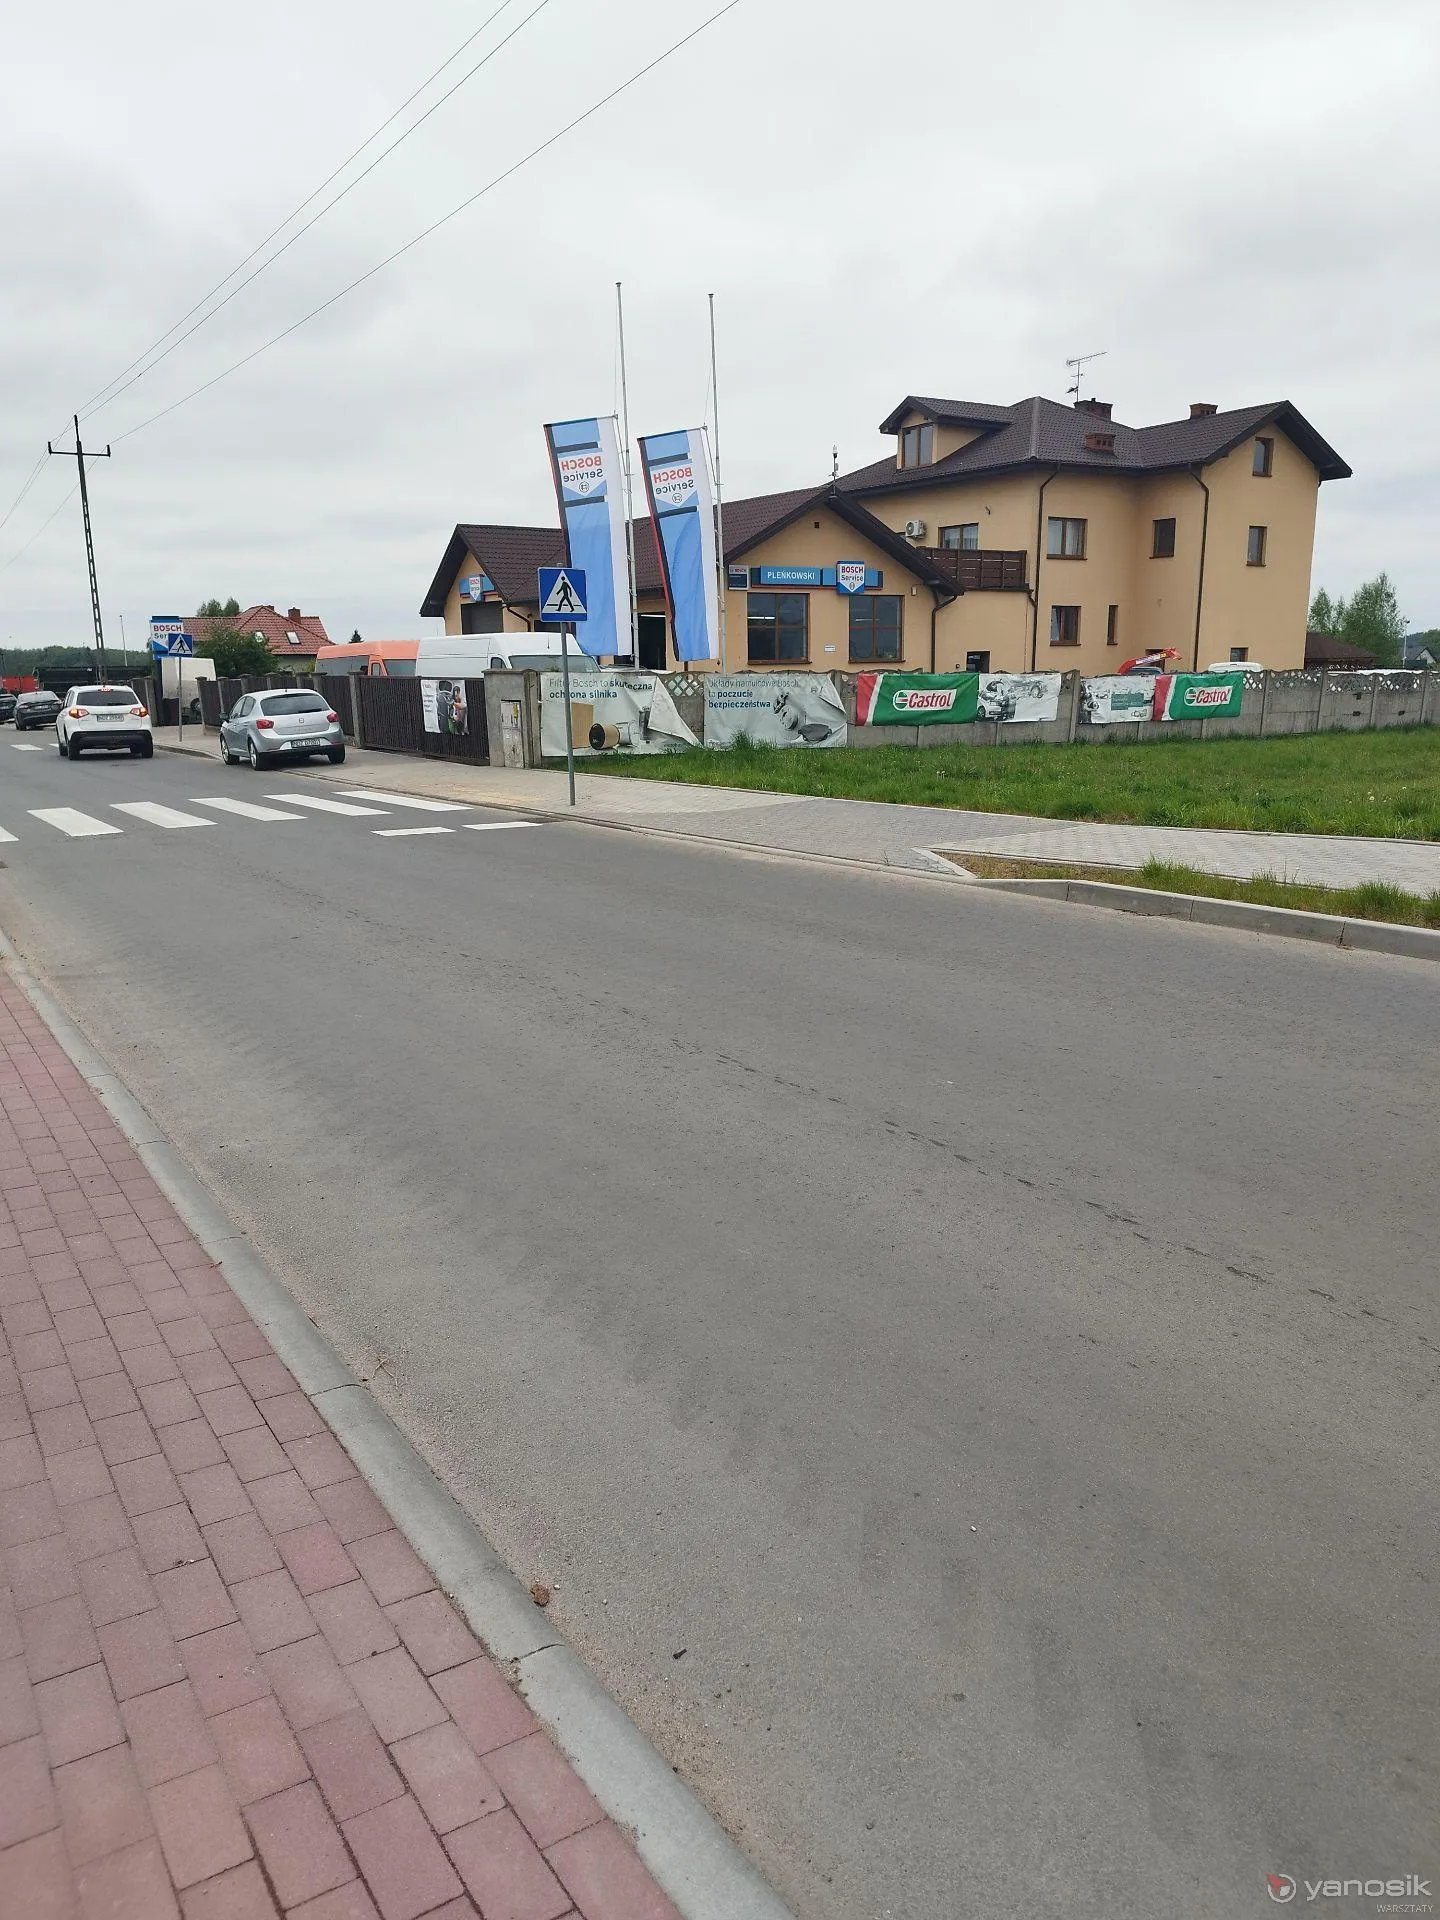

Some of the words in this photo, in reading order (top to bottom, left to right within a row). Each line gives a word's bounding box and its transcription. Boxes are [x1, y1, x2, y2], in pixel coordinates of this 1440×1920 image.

[767, 570, 815, 580] PLEŃKOWSKI
[841, 566, 864, 574] BOSCH
[841, 574, 864, 582] Service
[153, 624, 182, 632] BOSCH
[572, 678, 599, 688] Bosch
[600, 679, 609, 688] to
[609, 678, 653, 691] skuteczna
[549, 689, 587, 699] ochona
[589, 689, 618, 699] silnika
[708, 690, 716, 698] to
[717, 689, 753, 699] poczucie
[1196, 687, 1231, 704] Castrol
[708, 699, 771, 710] bezpieczeństwa
[908, 692, 951, 709] Castrol
